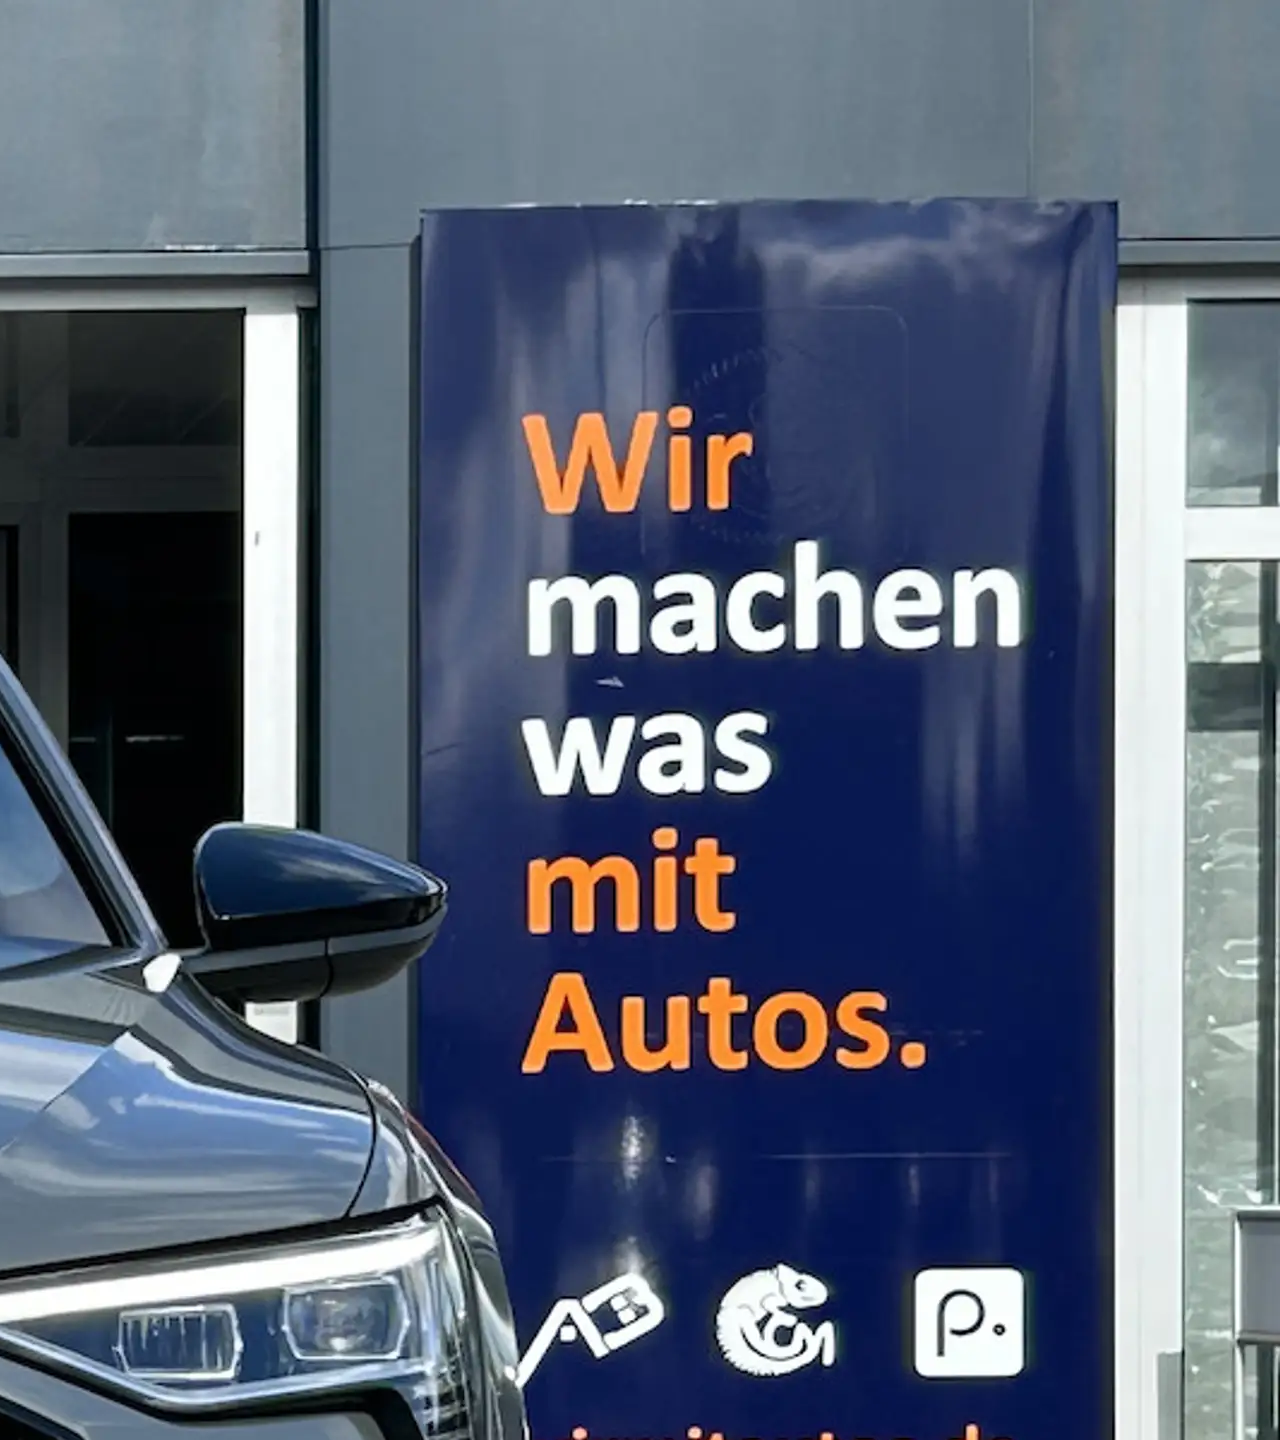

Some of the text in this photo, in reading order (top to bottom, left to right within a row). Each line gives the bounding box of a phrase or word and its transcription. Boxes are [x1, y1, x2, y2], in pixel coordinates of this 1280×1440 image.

[521, 406, 752, 515] Wir
[528, 541, 1021, 656] machen
[522, 712, 771, 795] was
[528, 828, 735, 933] mit
[522, 973, 925, 1073] Autos.
